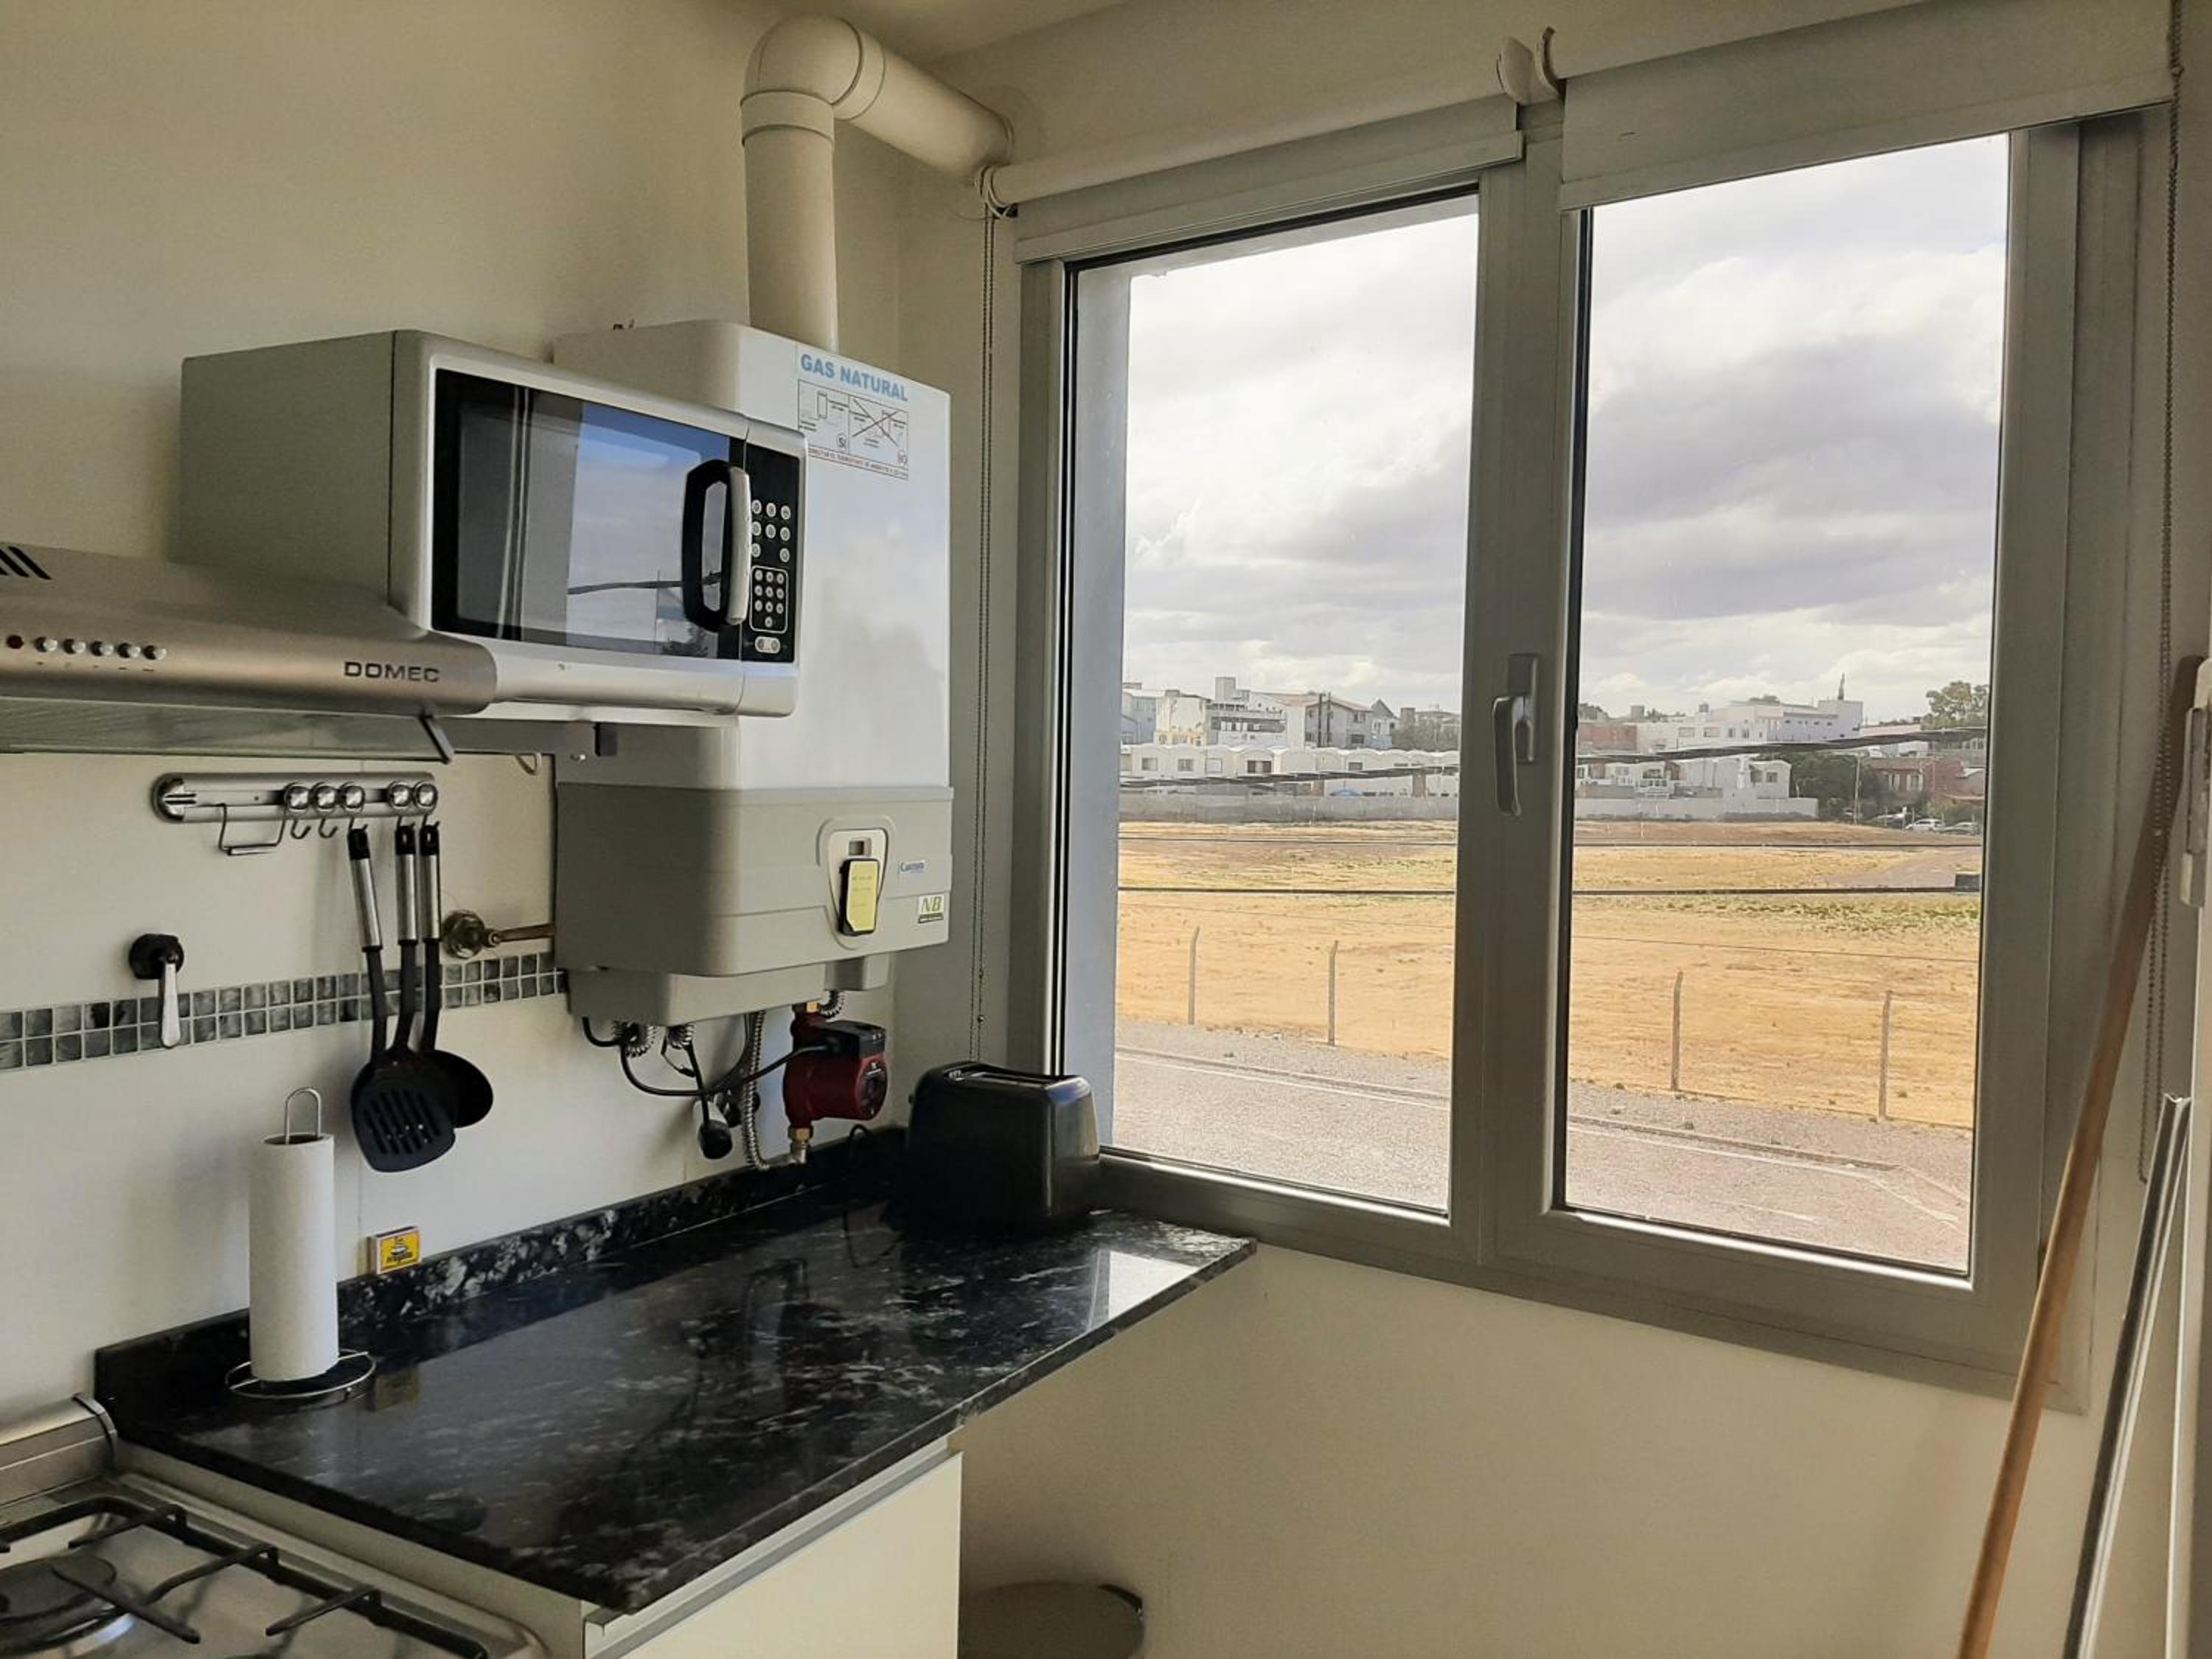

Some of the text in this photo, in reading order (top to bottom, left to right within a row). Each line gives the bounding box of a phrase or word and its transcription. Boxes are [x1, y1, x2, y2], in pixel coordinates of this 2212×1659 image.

[801, 354, 908, 401] GAS NATURAL
[344, 661, 440, 683] DOMEC
